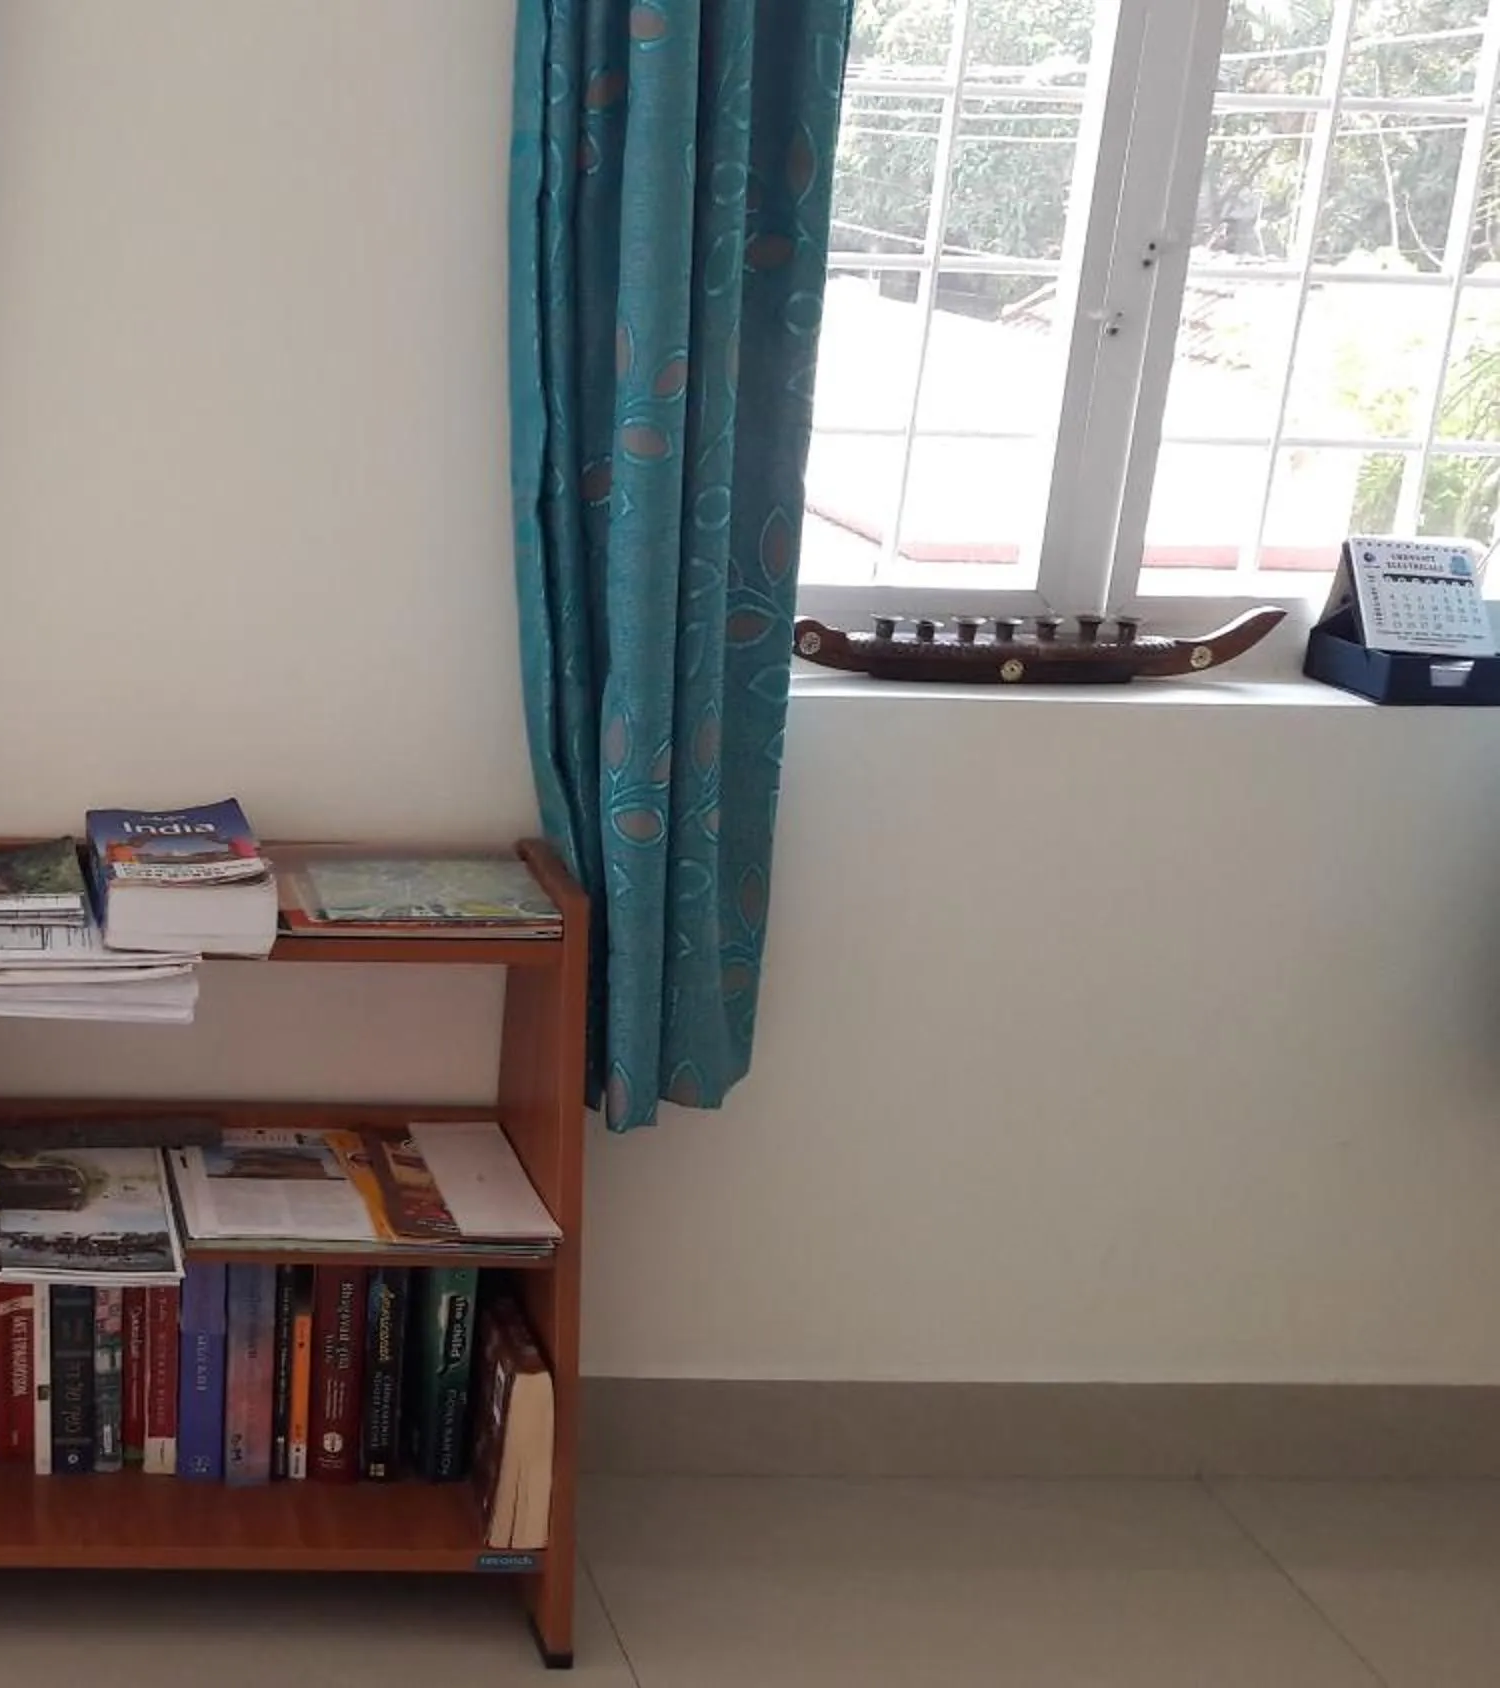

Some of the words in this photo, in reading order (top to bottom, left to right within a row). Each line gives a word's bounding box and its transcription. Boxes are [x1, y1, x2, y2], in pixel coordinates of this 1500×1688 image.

[122, 820, 217, 836] India
[377, 1284, 396, 1362] Americanah
[455, 1295, 468, 1321] the
[450, 1323, 466, 1358] child
